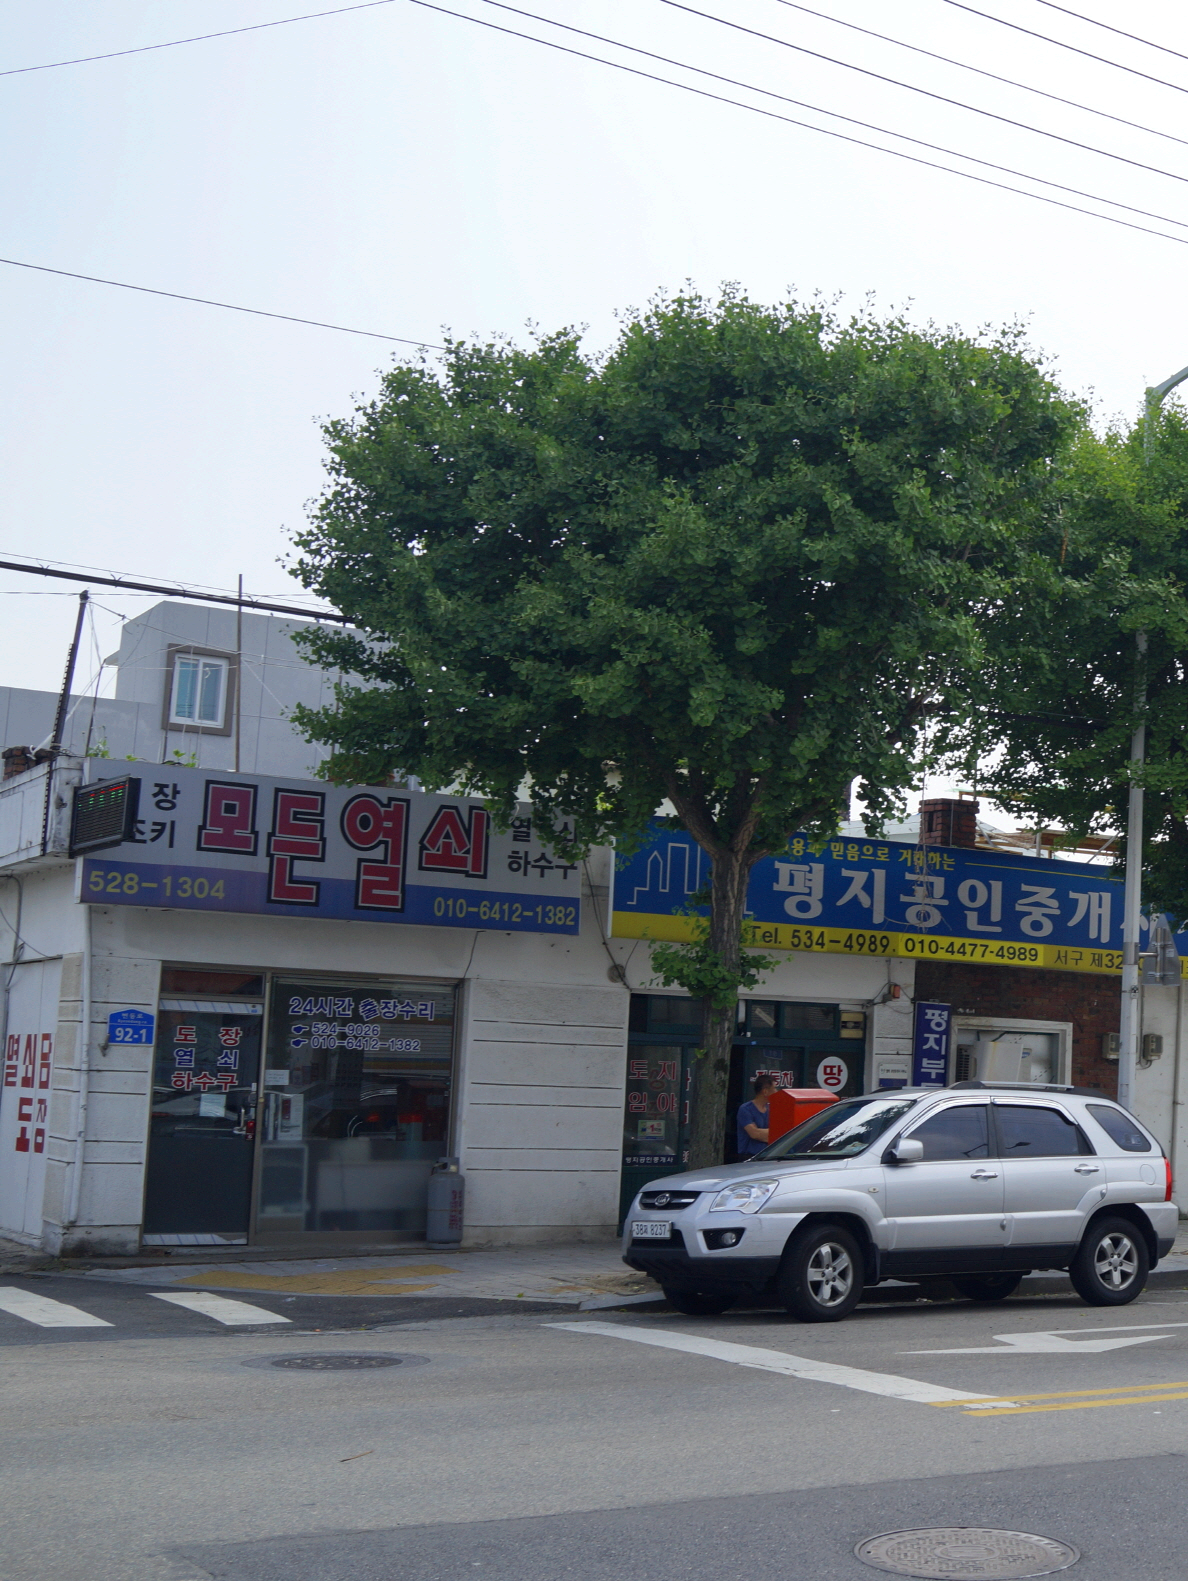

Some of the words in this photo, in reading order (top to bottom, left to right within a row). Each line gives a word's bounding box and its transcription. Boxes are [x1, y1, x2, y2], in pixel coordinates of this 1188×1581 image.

[197, 779, 490, 914] 모든열쇠
[831, 842, 890, 861] 믿음으로
[507, 850, 578, 880] 하수구
[88, 870, 226, 900] 528-1304
[433, 896, 577, 926] 010-6412-1382
[904, 938, 1038, 963] 010-4477-4989
[1054, 950, 1084, 967] 서구
[289, 996, 354, 1018] 24시간
[358, 997, 435, 1022] 출장수리
[115, 1027, 147, 1043] 92-1
[174, 1025, 243, 1046] 도장
[311, 1023, 381, 1037] 524-9026
[310, 1036, 421, 1052] 010-6412-1382
[174, 1048, 240, 1070] 열쇠
[628, 1059, 677, 1081] 토지
[171, 1071, 238, 1093] 하수구
[823, 1064, 844, 1087] 땅
[628, 1092, 677, 1113] 임야
[15, 1096, 48, 1154] 도장
[650, 1223, 667, 1236] 8237
